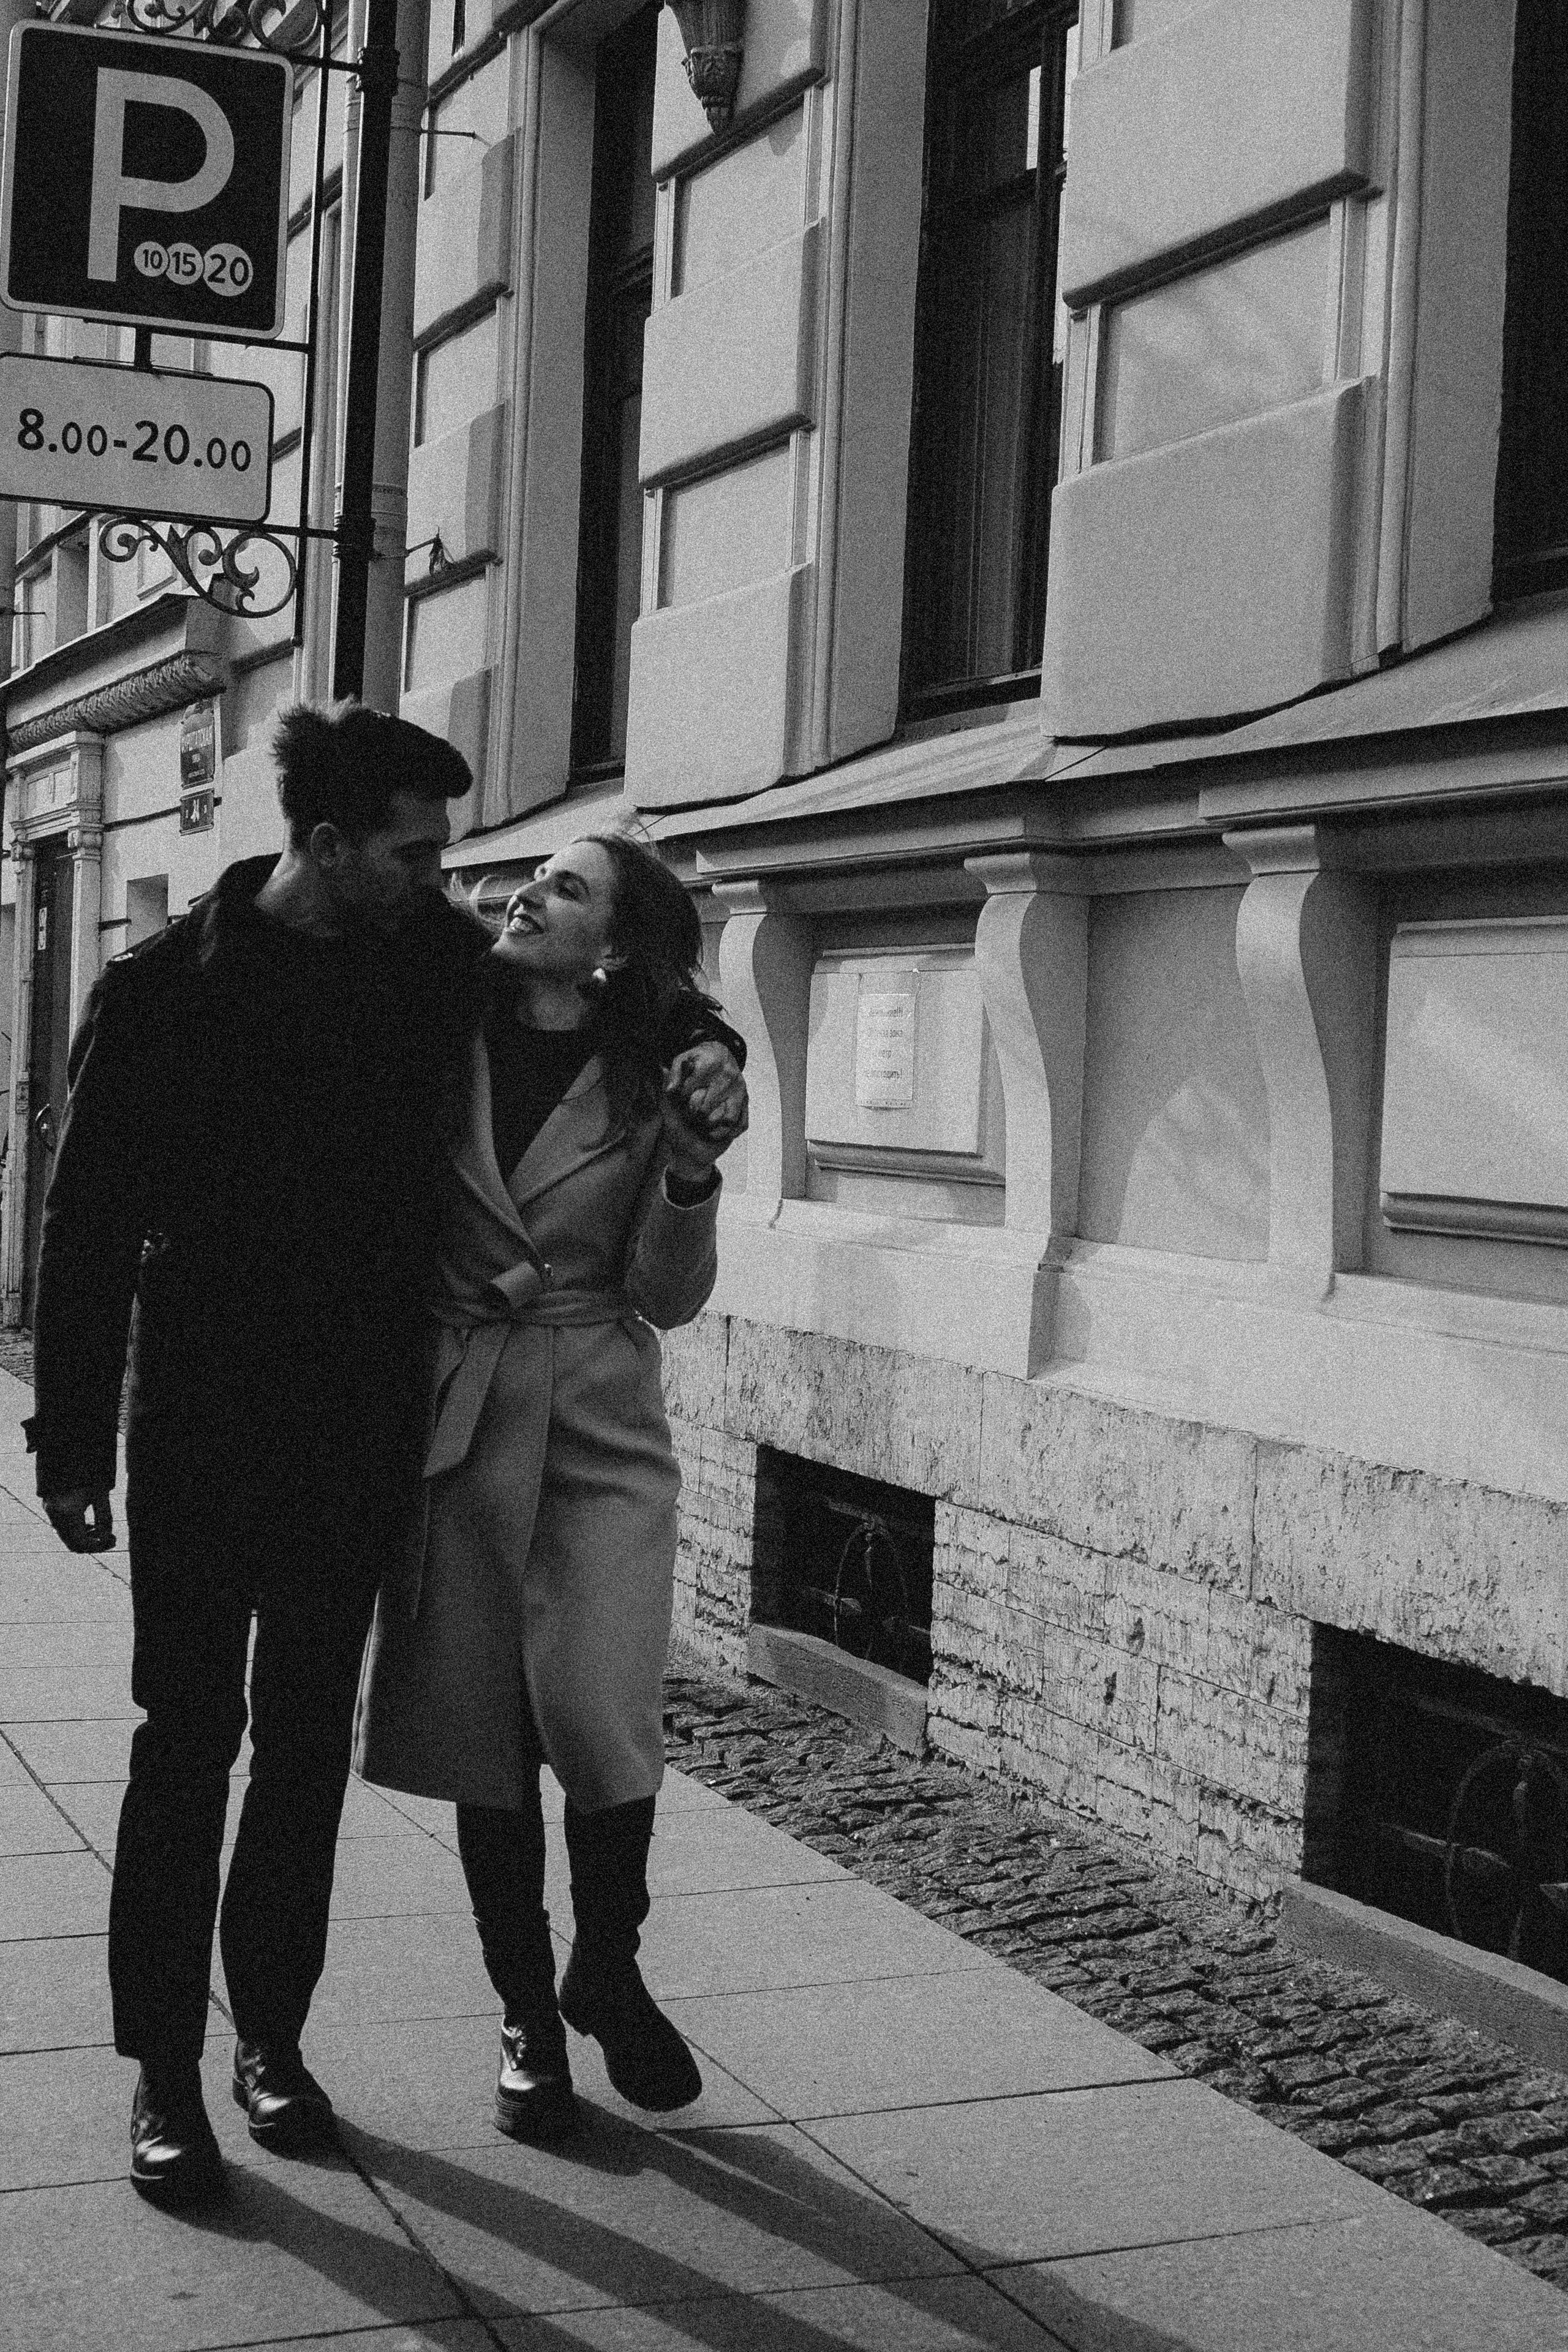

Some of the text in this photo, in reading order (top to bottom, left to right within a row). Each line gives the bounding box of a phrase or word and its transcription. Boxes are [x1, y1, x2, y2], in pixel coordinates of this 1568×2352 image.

[88, 67, 235, 282] P
[143, 249, 249, 287] 10 15 20
[17, 408, 251, 472] 8.00-20.00
